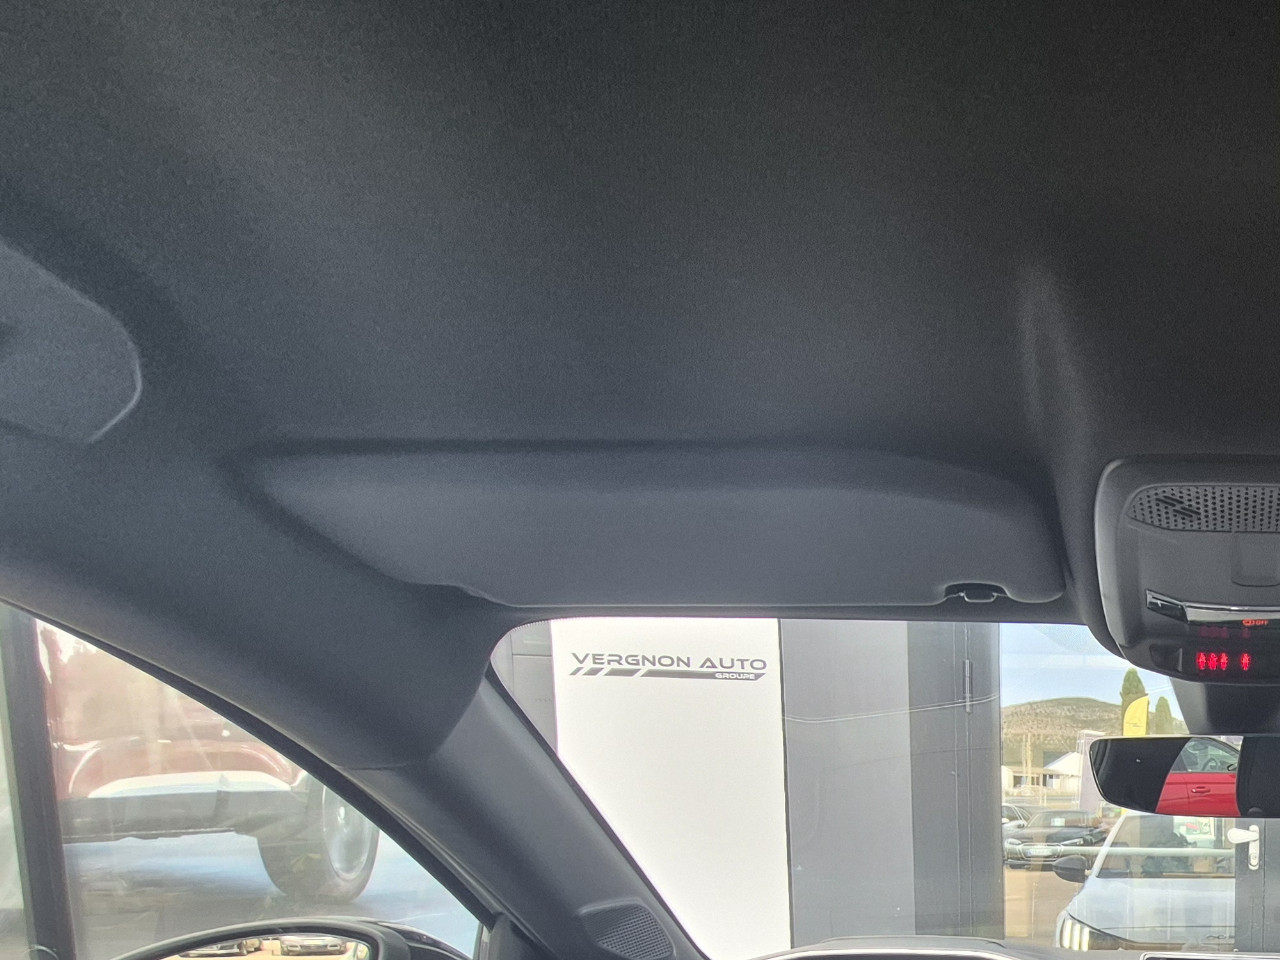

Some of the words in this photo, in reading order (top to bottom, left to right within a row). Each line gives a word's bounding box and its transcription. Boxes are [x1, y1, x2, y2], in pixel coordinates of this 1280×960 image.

[571, 652, 691, 669] VERGNON
[699, 656, 767, 670] AUTO
[715, 672, 756, 680] GROUPE
